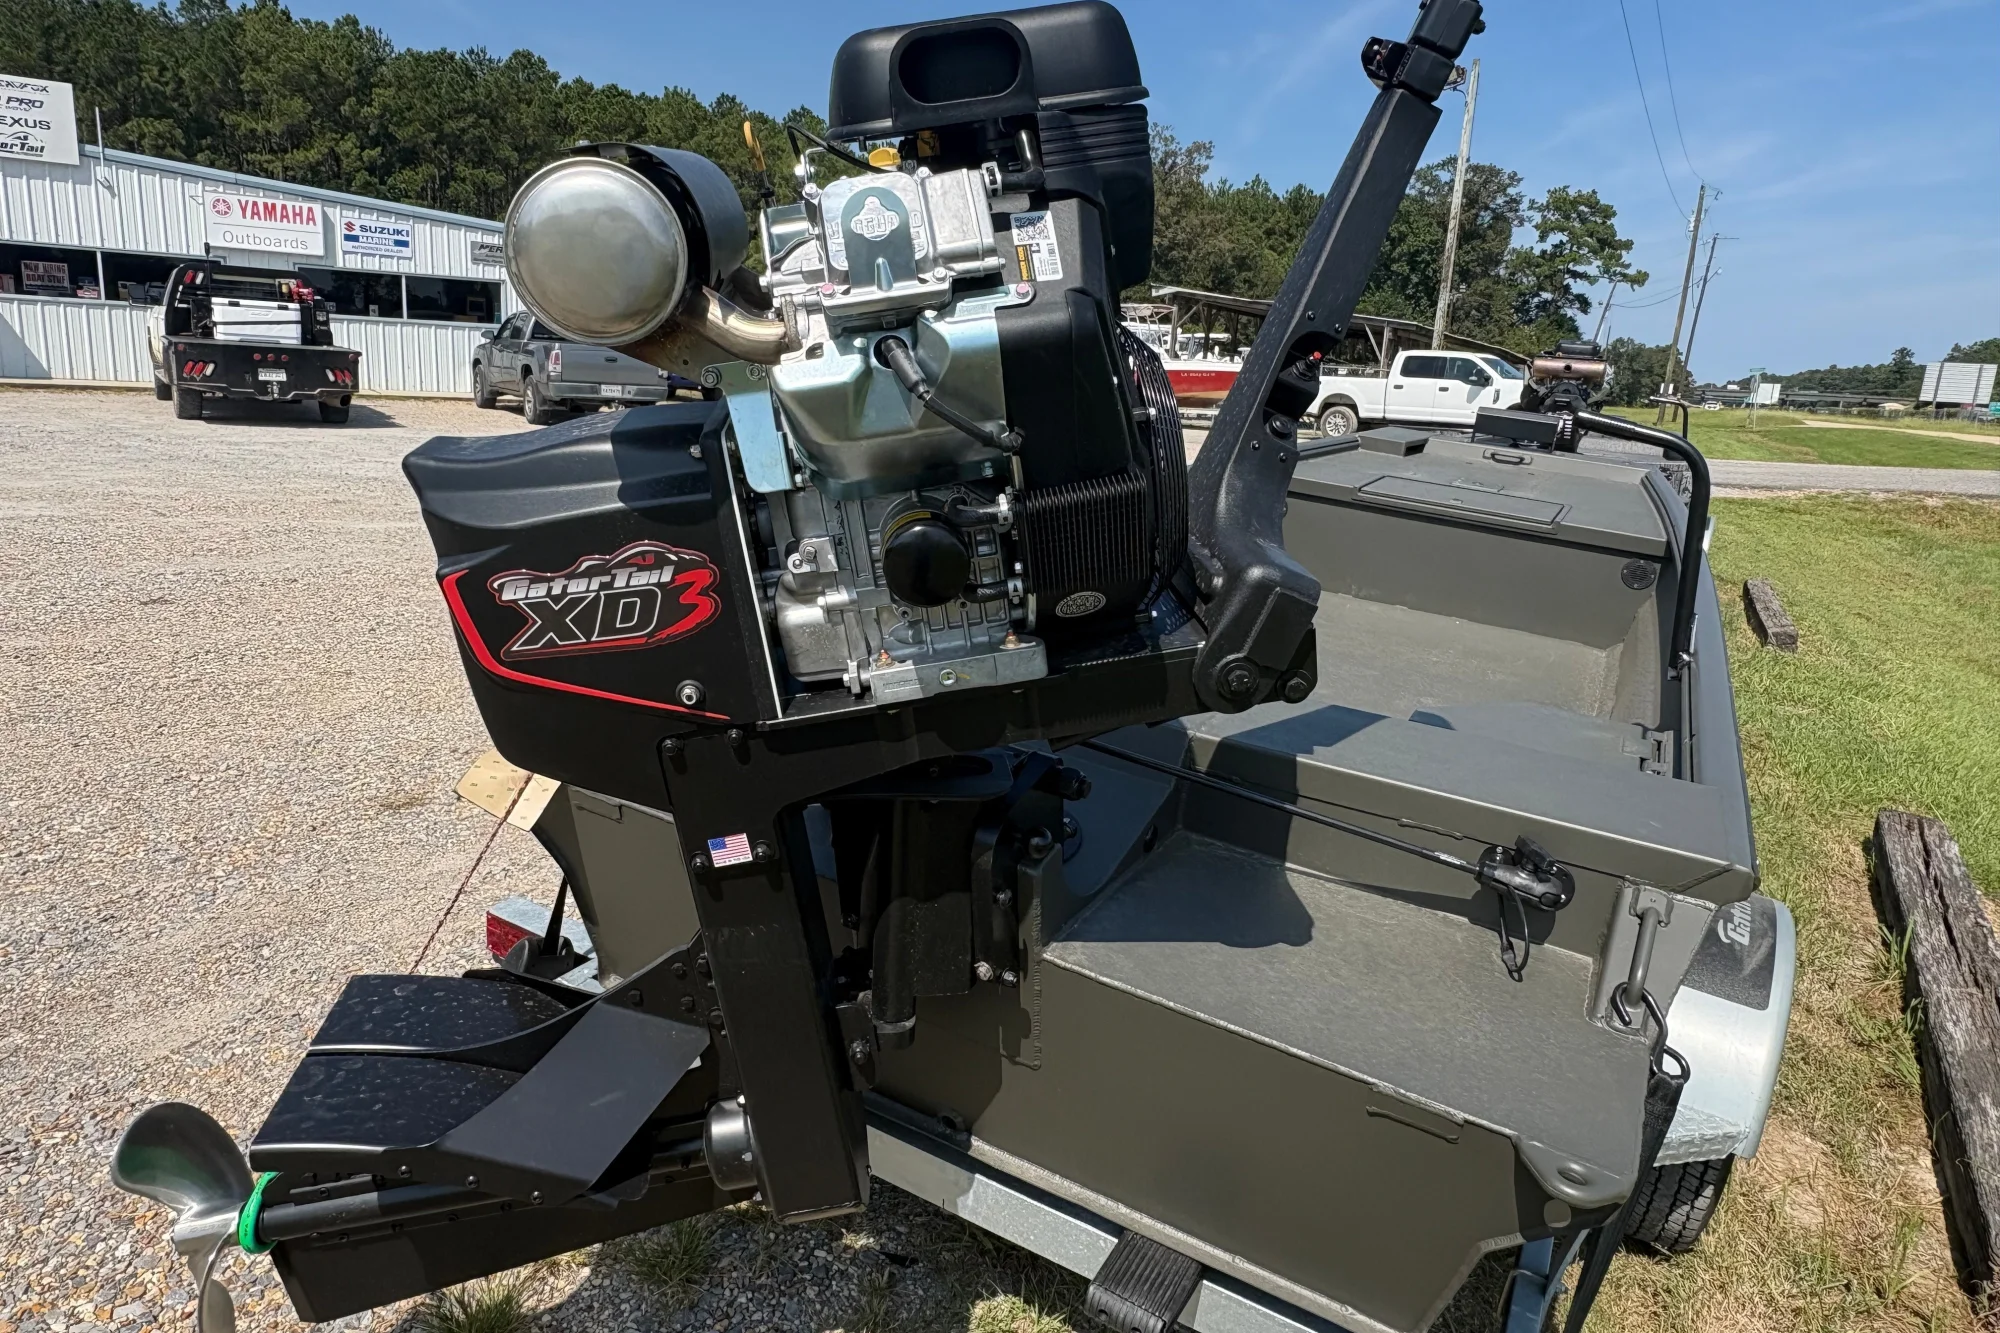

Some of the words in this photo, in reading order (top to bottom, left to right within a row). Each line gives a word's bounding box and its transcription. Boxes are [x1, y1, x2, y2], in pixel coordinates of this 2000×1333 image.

[237, 198, 317, 226] YAMAHA
[222, 230, 308, 250] Outboards
[358, 235, 395, 246] MARINE
[359, 225, 409, 237] SUZUKI
[501, 565, 675, 601] GatorTail
